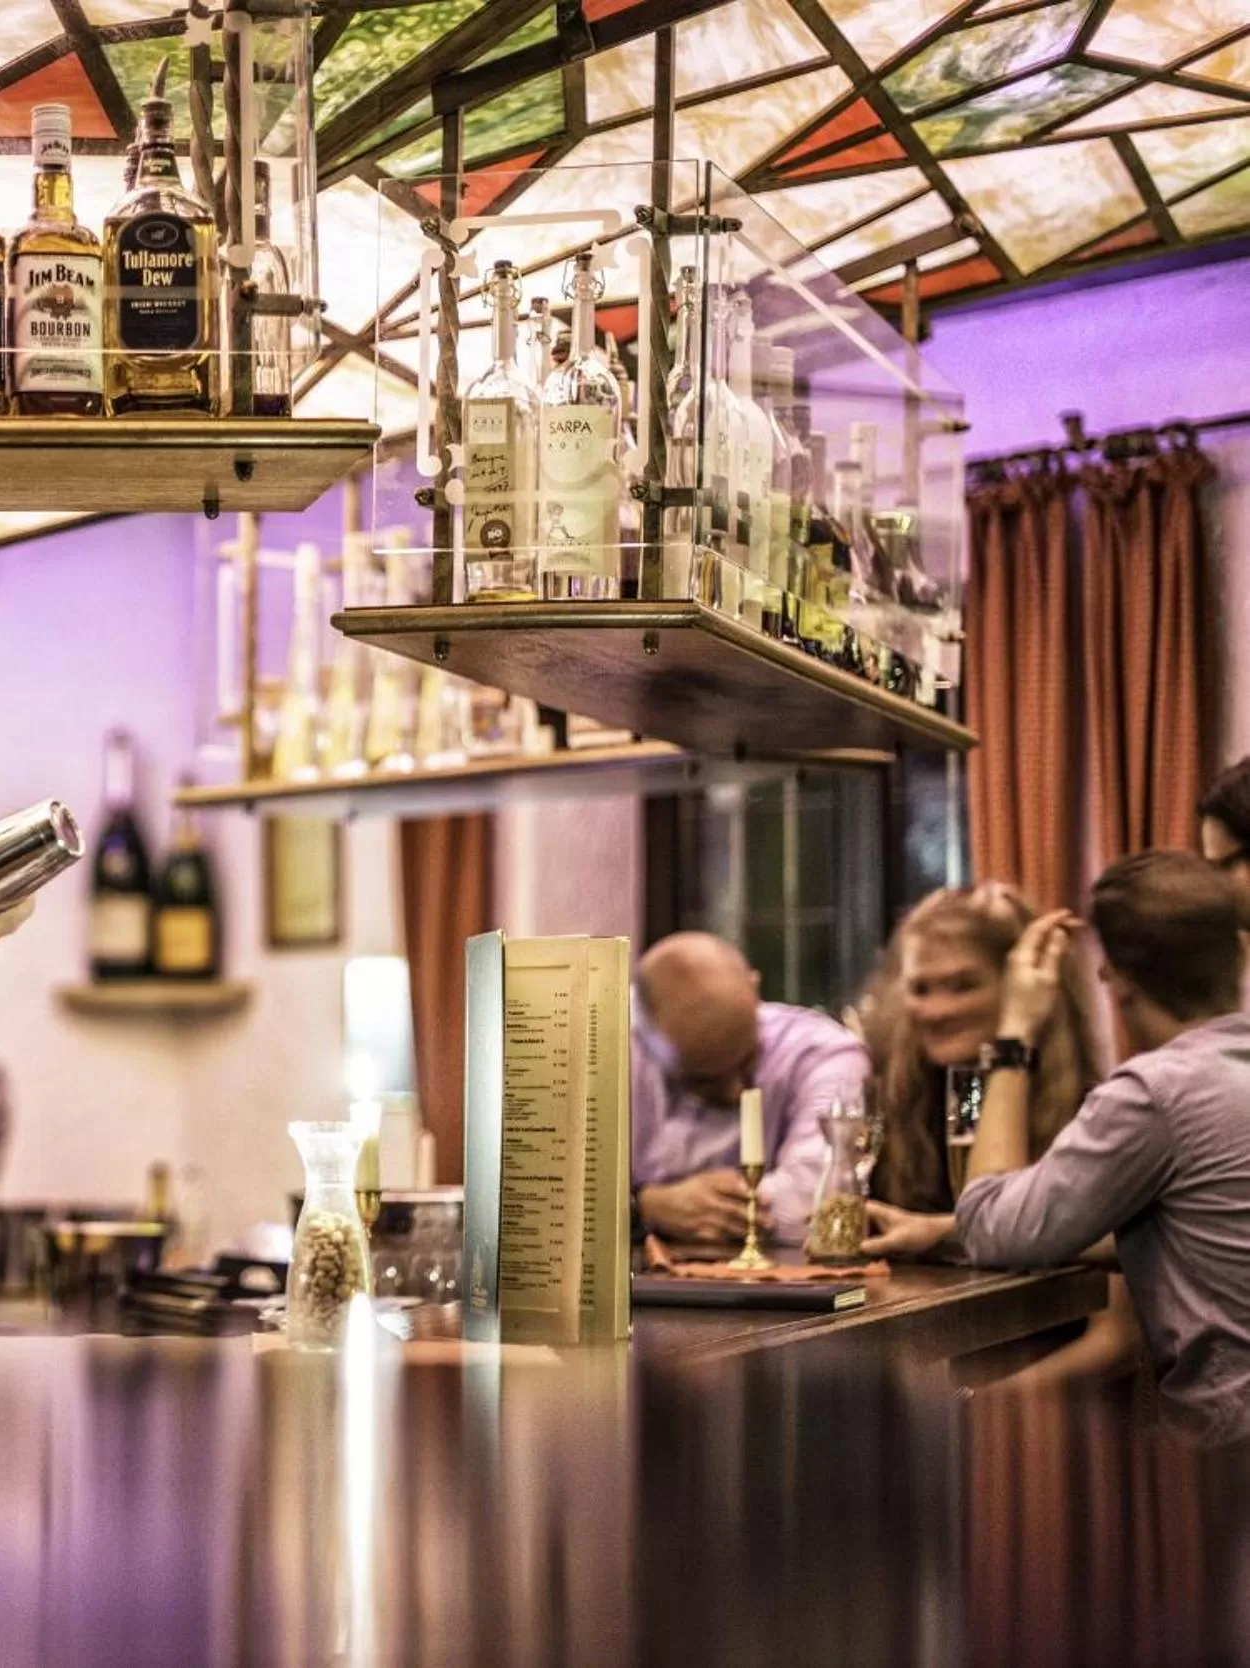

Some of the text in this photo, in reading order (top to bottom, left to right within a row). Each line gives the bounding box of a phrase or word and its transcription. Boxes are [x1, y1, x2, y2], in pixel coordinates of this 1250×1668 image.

[122, 250, 194, 269] Tullamore
[26, 264, 95, 293] JIM BEAM
[142, 269, 174, 286] Dew
[31, 321, 91, 337] BOURBON
[549, 419, 593, 434] SARPA
